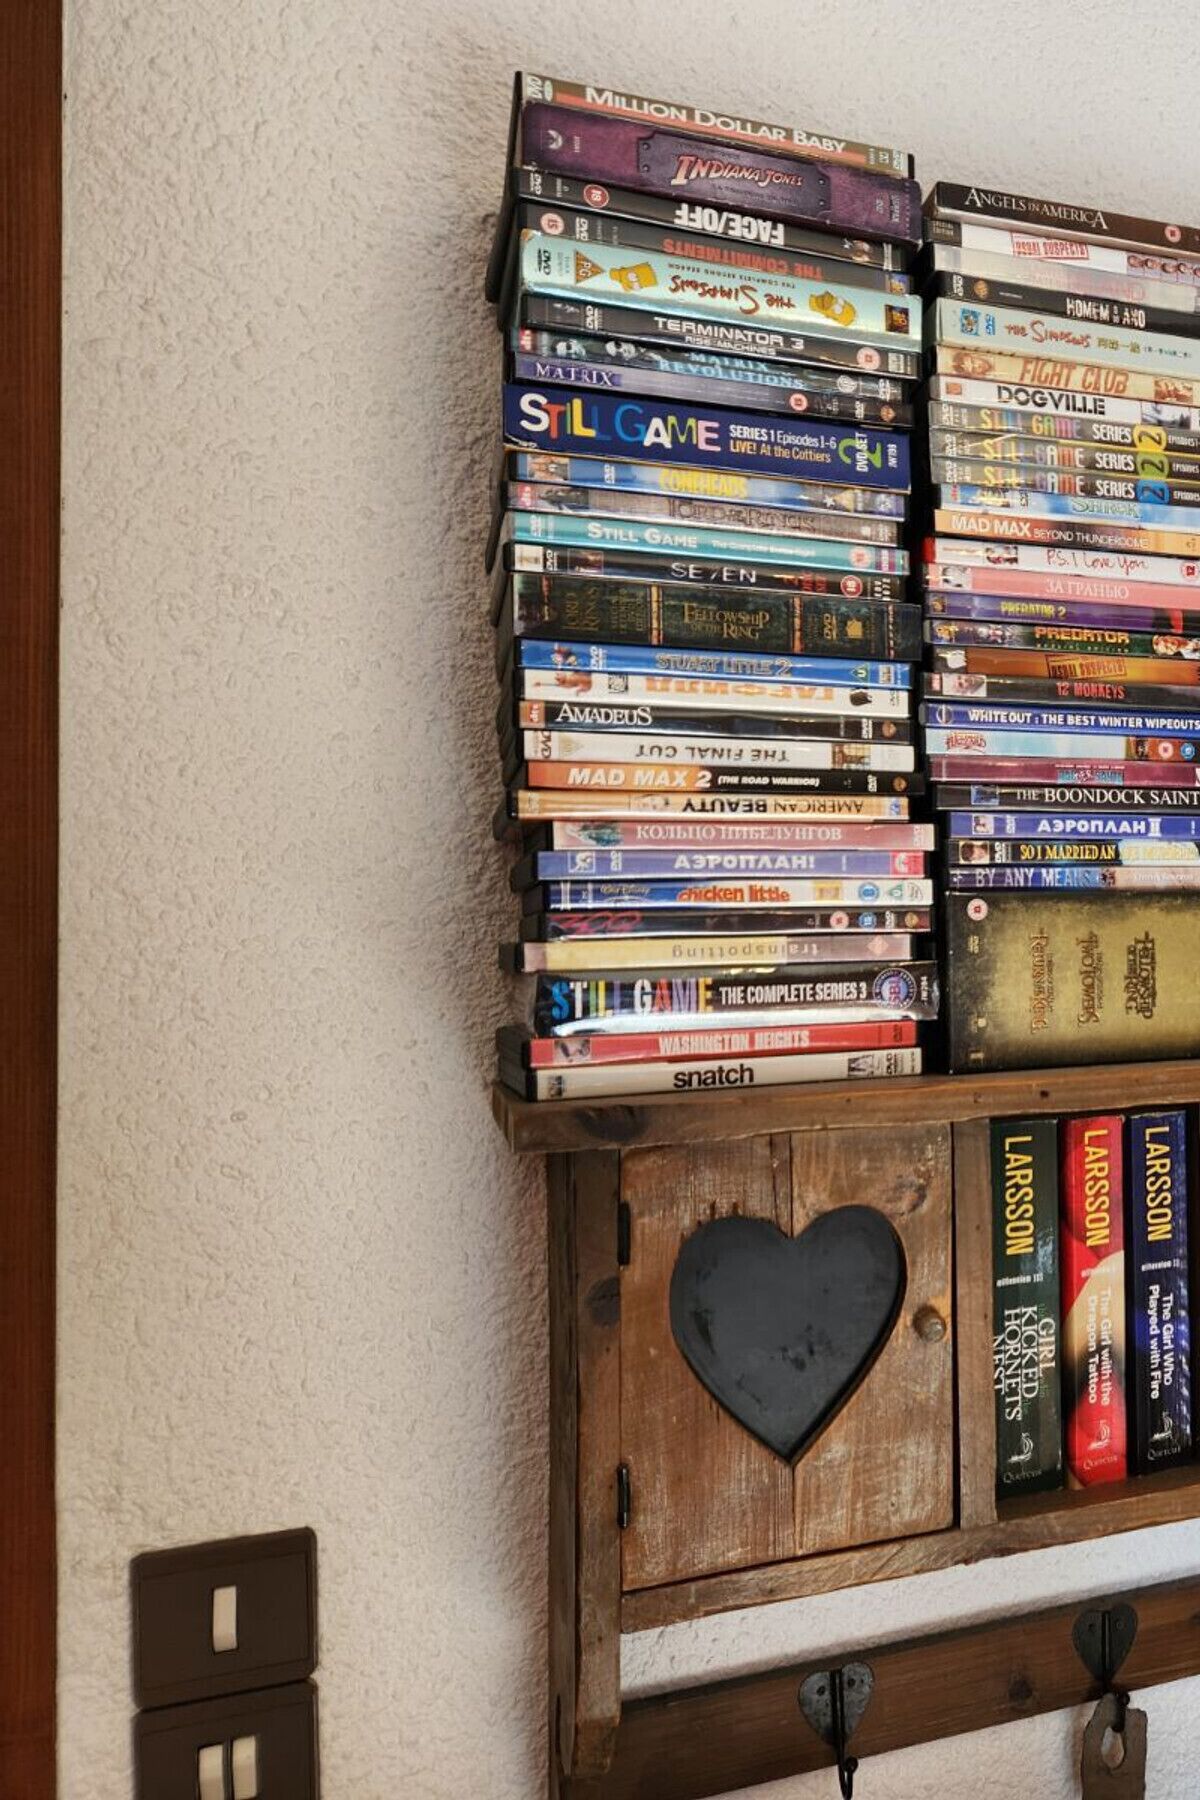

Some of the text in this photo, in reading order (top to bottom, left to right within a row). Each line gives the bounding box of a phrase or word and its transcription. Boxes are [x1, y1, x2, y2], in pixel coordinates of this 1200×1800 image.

[586, 88, 846, 153] MILLION DOLLAR BABY
[671, 155, 803, 188] INDIANA JONES
[964, 188, 1026, 211] ANGELS
[1041, 204, 1108, 230] AMERICA
[673, 203, 785, 246] FACE/OFF
[662, 239, 823, 280] THE COMMITMENTS
[654, 317, 805, 351] TERMINATOR 3
[535, 362, 614, 387] MATRIX
[659, 359, 806, 390] REVOLUTIONS
[1020, 360, 1130, 394] FIGHT CLUB
[997, 386, 1106, 415] DOGVILLE
[520, 392, 722, 451] STILL GAME
[730, 424, 837, 449] SERIES 1 Episodes 1-6
[730, 440, 831, 464] LIVE! At the Cottiers
[588, 523, 698, 548] STILL GAME
[952, 515, 1148, 547] MAD MAX BEYOND THUNDERDOME
[683, 602, 769, 627] FELLOWSHIP
[1035, 626, 1130, 643] PREDATOR
[1056, 682, 1125, 700] 12 MONKEYS
[556, 702, 653, 726] AMADEUS
[968, 710, 1200, 730] WHITEOUT THE BEST WINTER WIPEOUTS
[636, 743, 791, 761] THE FINAL CUT
[567, 767, 820, 788] MAD MAX 2 (THE ROAD WARRIOR)
[682, 798, 864, 814] AMERICAN BEAUTY
[1016, 788, 1040, 800] THE
[1044, 787, 1145, 803] BOONDOCK
[636, 825, 842, 841] КОЛЬЦО НИБЕЛУНГОВ
[1038, 818, 1162, 837] АЭРОПЛАН II
[674, 854, 816, 870] АЭРОПЛАН!
[1020, 845, 1034, 859] SO
[1043, 845, 1098, 859] MARRIED
[1099, 845, 1116, 859] AN
[676, 884, 791, 903] chicken little
[671, 943, 819, 958] trainspotting
[719, 983, 867, 1005] THE COMPLETE SERIES 3
[660, 1030, 810, 1056] WASHINGTON HEIGHTS
[674, 1063, 754, 1089] snatch
[1005, 1135, 1034, 1256] LARSSON
[1083, 1128, 1110, 1247] LARSSON
[1145, 1126, 1173, 1241] LARSSON
[1021, 1306, 1038, 1399] KICKED
[1038, 1318, 1056, 1376] GIRL
[1085, 1295, 1099, 1403] Dragon Tattoo
[1099, 1289, 1112, 1406] The Girl with the
[1147, 1284, 1161, 1399] Played with Fire
[1162, 1293, 1174, 1385] The Girl Who
[993, 1334, 1004, 1395] NEST
[1004, 1309, 1021, 1421] HORNETS'
